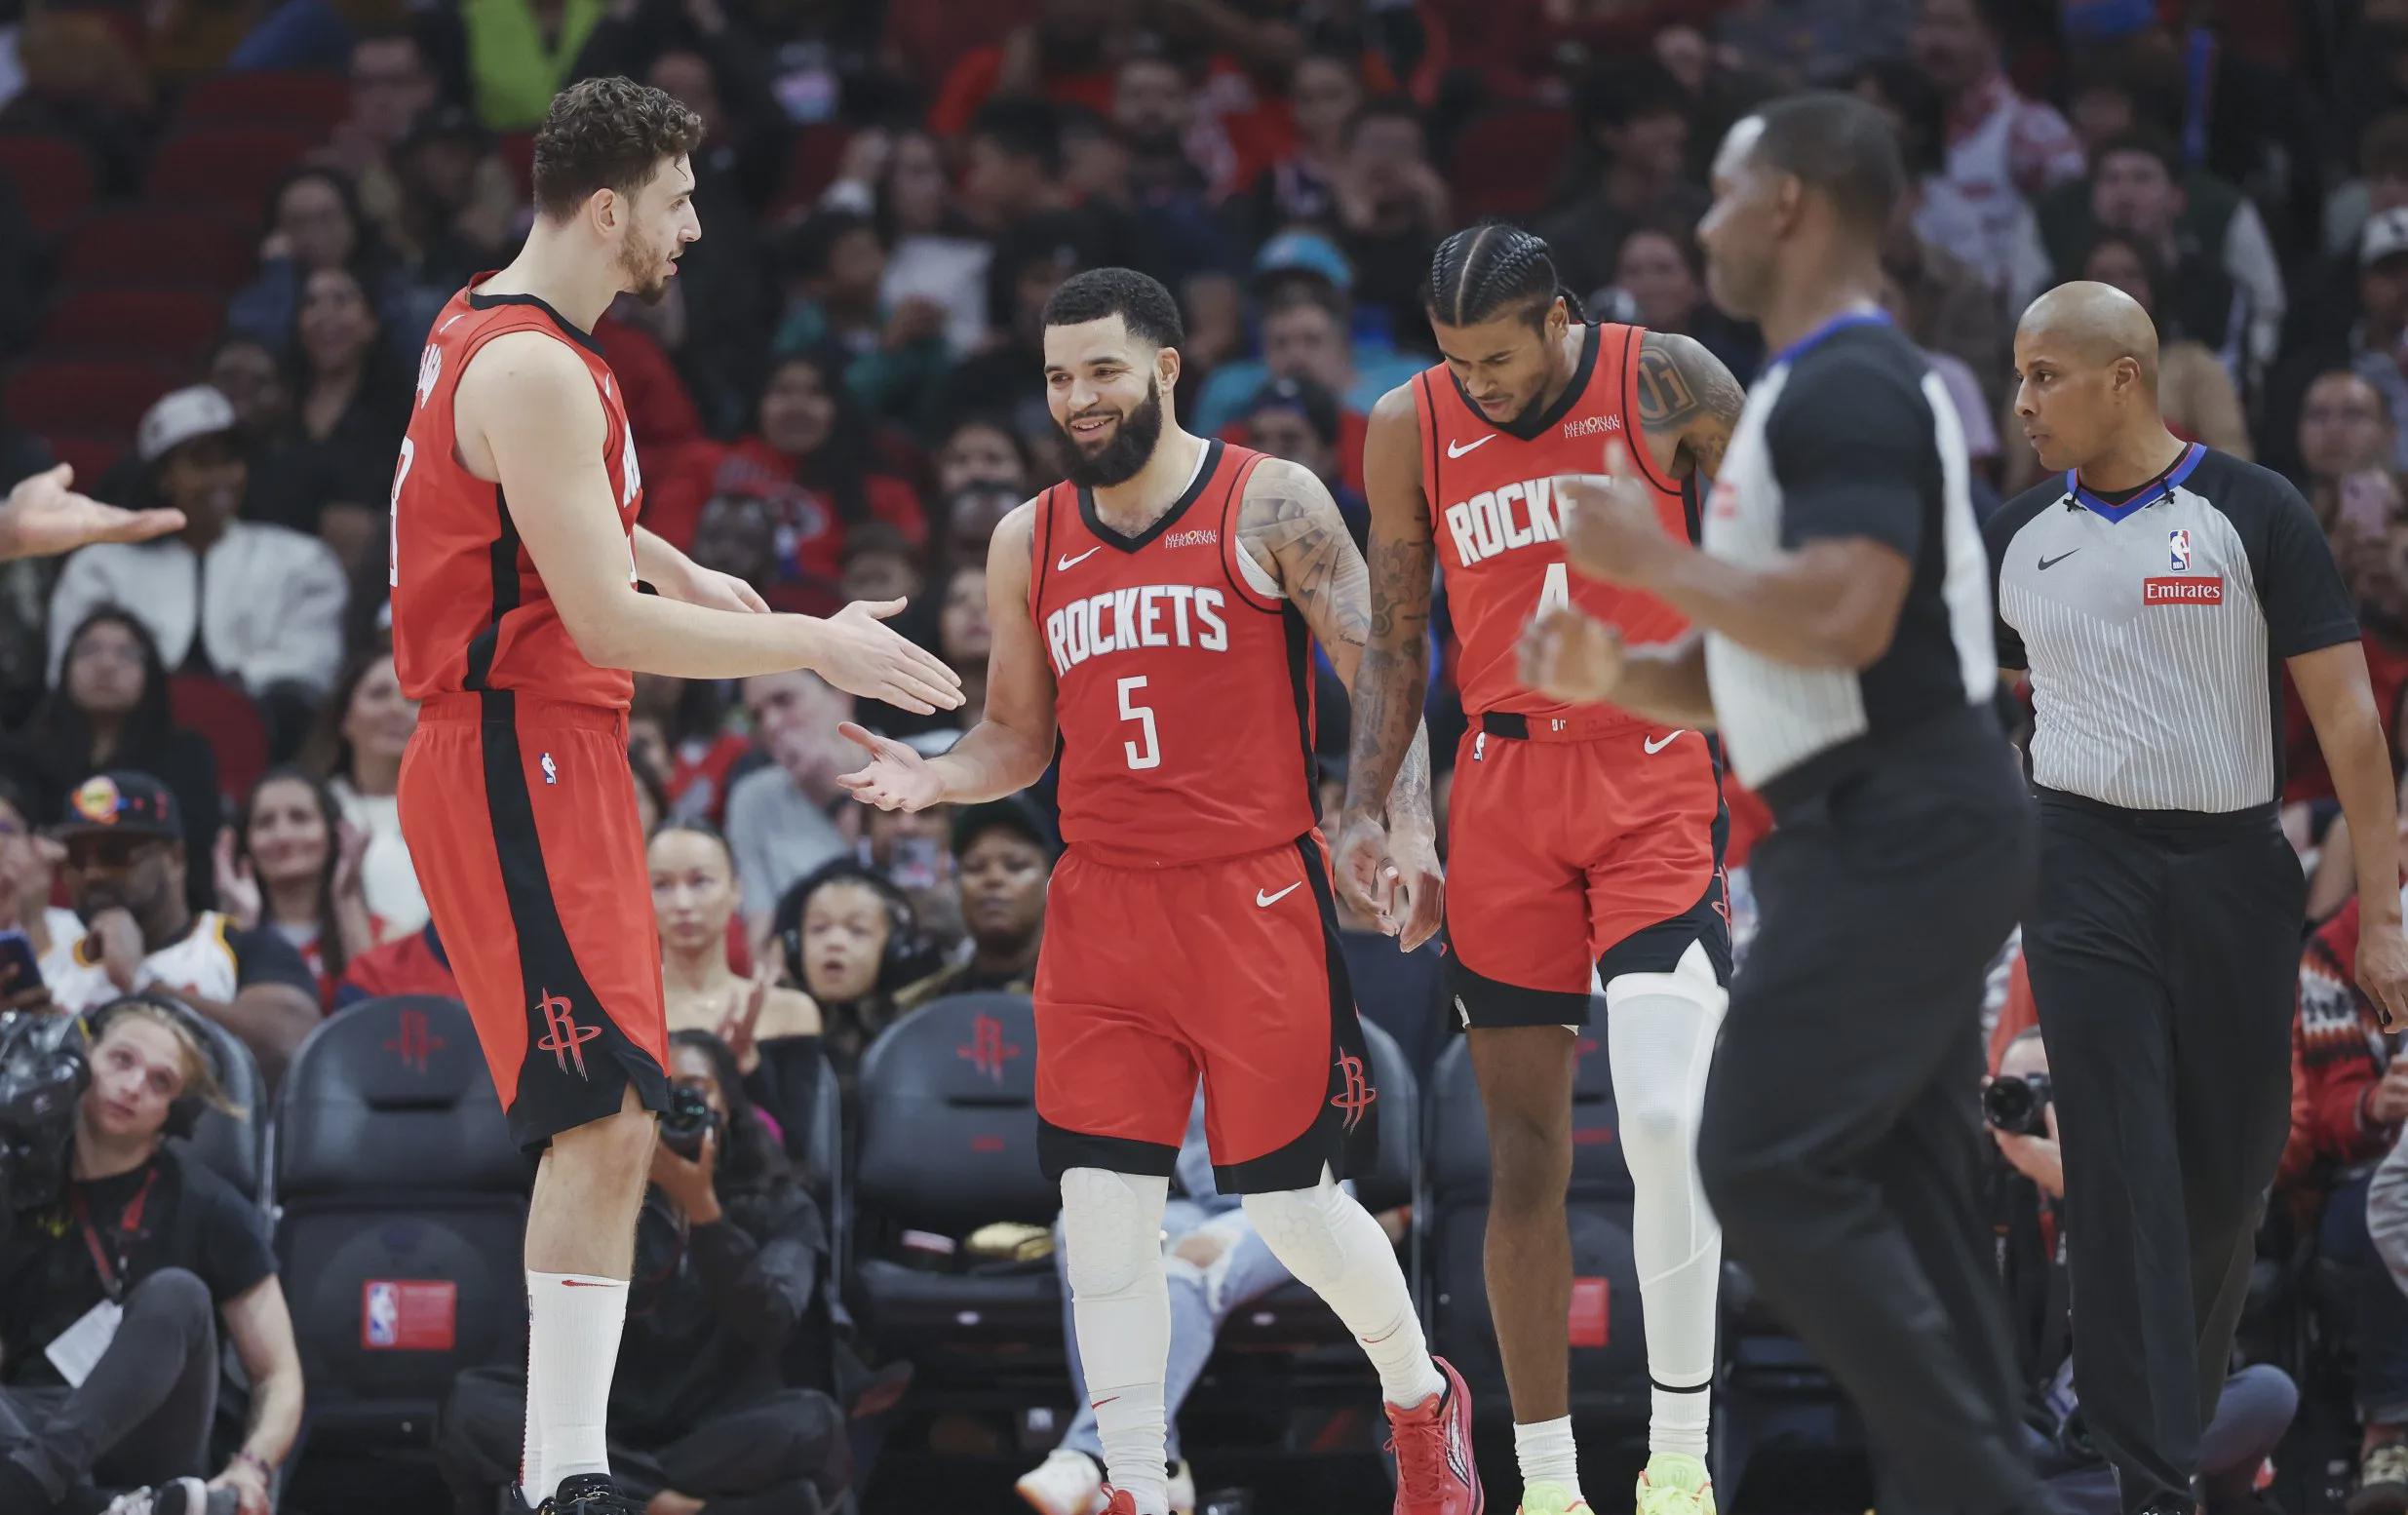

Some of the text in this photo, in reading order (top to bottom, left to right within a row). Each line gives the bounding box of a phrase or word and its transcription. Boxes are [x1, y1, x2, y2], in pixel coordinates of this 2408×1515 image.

[1564, 414, 1620, 431] MEMORIAL
[1565, 420, 1620, 439] HERMANN
[1165, 530, 1217, 542] MEMORIAL
[1165, 536, 1217, 549] HERMANN
[2147, 582, 2220, 599] Emirates
[1046, 584, 1228, 679] ROCKETS
[1116, 675, 1161, 770] 5
